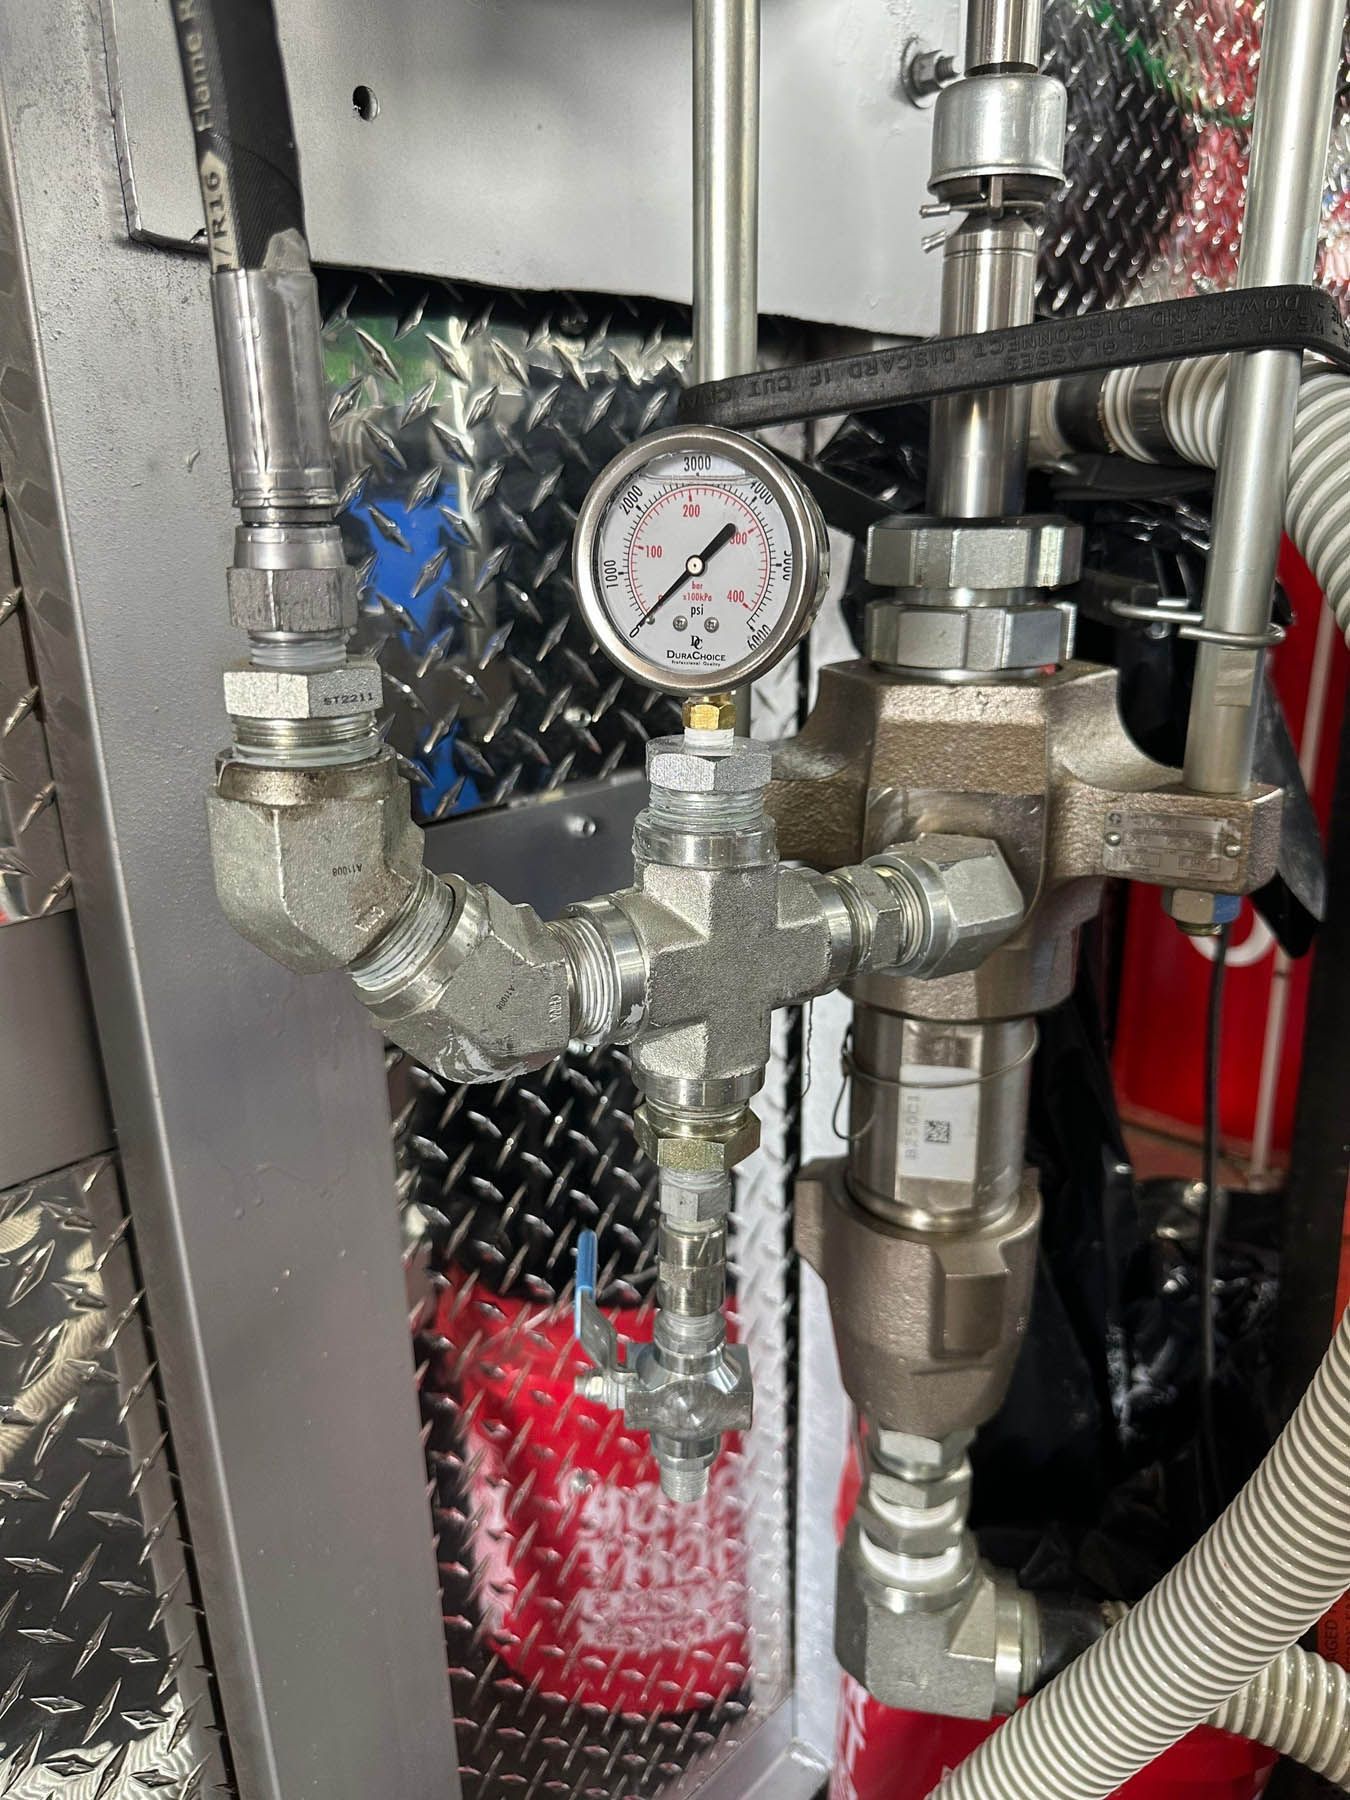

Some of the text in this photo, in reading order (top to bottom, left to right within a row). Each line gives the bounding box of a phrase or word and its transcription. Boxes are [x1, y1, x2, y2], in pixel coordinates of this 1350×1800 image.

[185, 31, 214, 133] Flame
[1153, 302, 1209, 328] AND
[1223, 295, 1300, 318] DOWN
[1137, 317, 1239, 351] SAFETY
[1258, 314, 1324, 336] WEAR
[973, 317, 1132, 359] DISCONNECT
[850, 349, 956, 378] DISCARD
[1005, 342, 1118, 371] GLASSES
[748, 376, 792, 398] CUT
[808, 367, 832, 387] IF
[683, 455, 712, 472] 3000
[619, 485, 644, 516] 2000
[749, 480, 774, 505] 4000
[682, 504, 701, 518] 200
[646, 545, 663, 559] 100
[603, 559, 620, 589] 1000
[692, 581, 703, 590] bar
[727, 590, 745, 603] 400
[690, 603, 704, 618] psi
